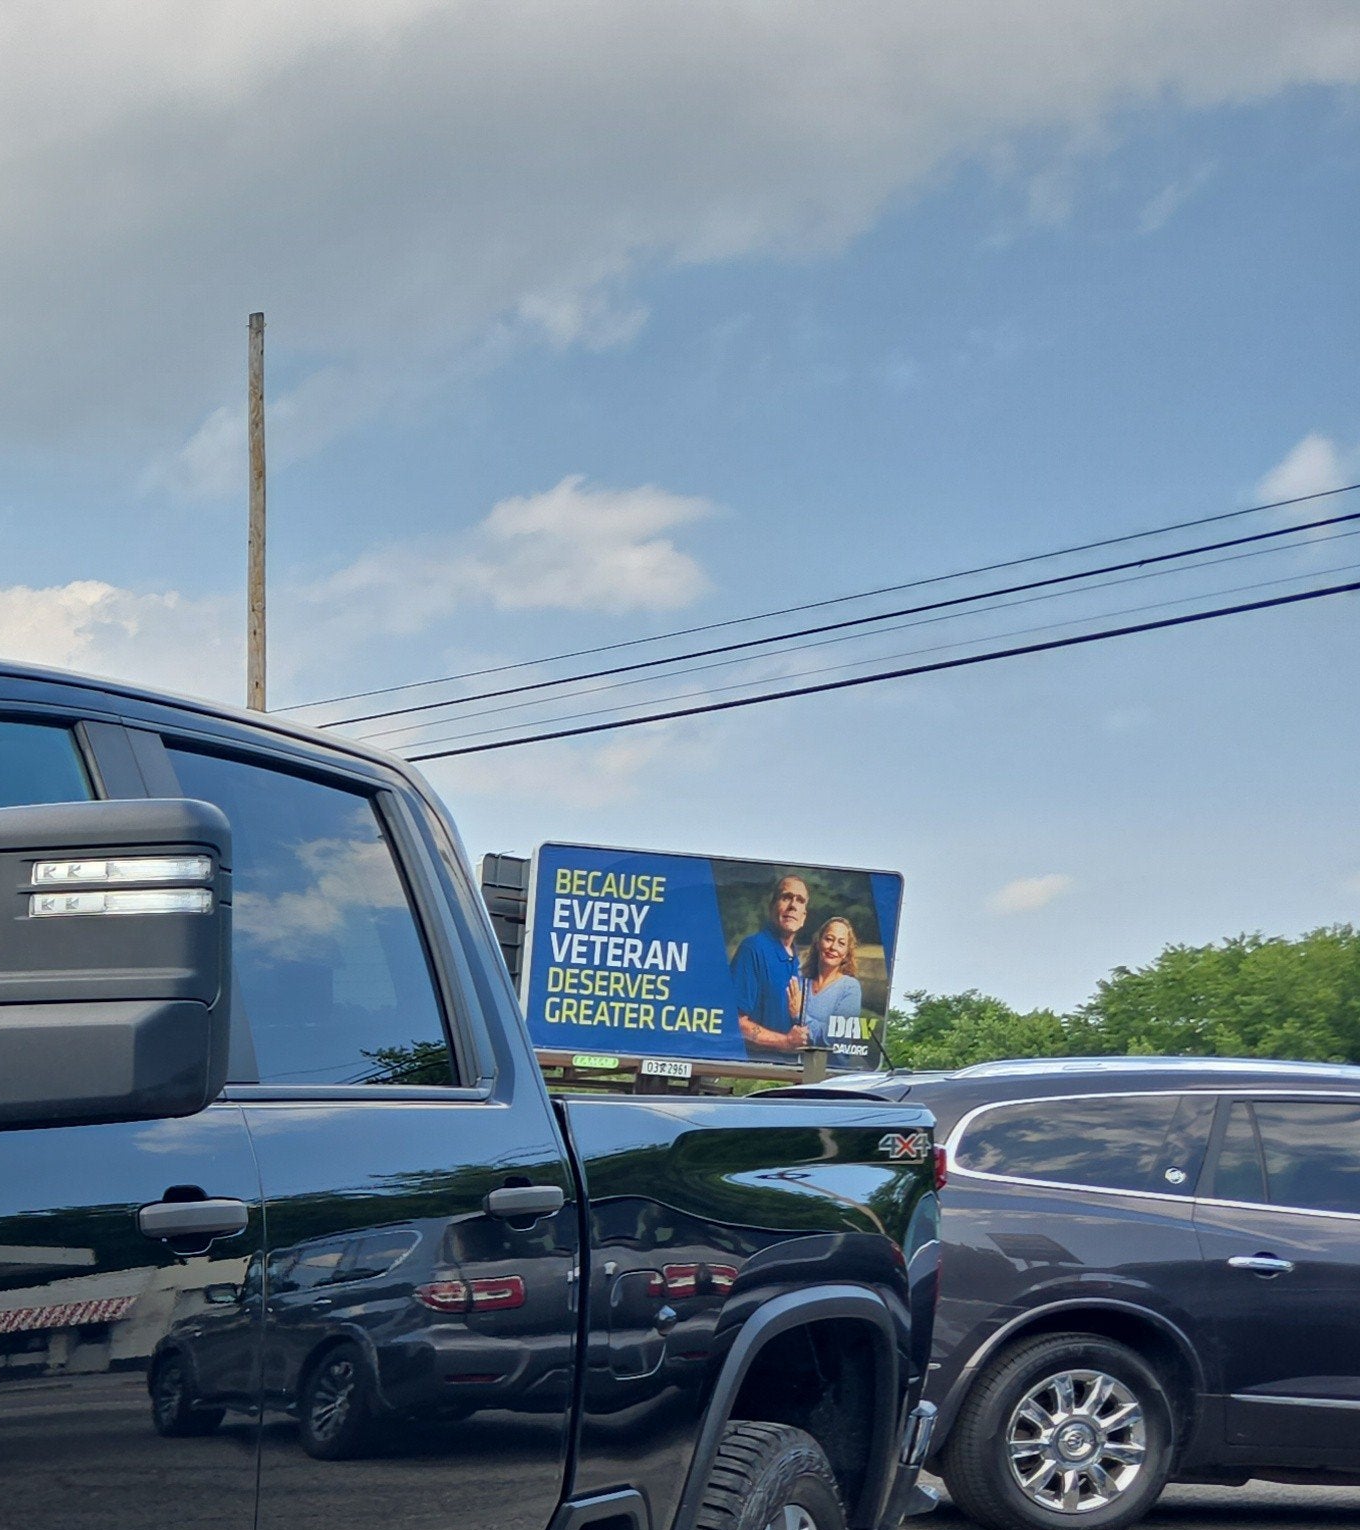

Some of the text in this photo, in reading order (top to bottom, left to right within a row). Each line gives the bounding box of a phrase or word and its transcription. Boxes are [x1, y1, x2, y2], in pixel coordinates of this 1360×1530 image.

[554, 868, 667, 903] BECAUSE
[552, 898, 650, 934] EVERY
[550, 932, 688, 972] VETERAN
[547, 967, 671, 1001] DESERVES
[544, 997, 723, 1035] GREATER CARE
[827, 1015, 879, 1040] DAV
[833, 1043, 869, 1056] DAV.ORG
